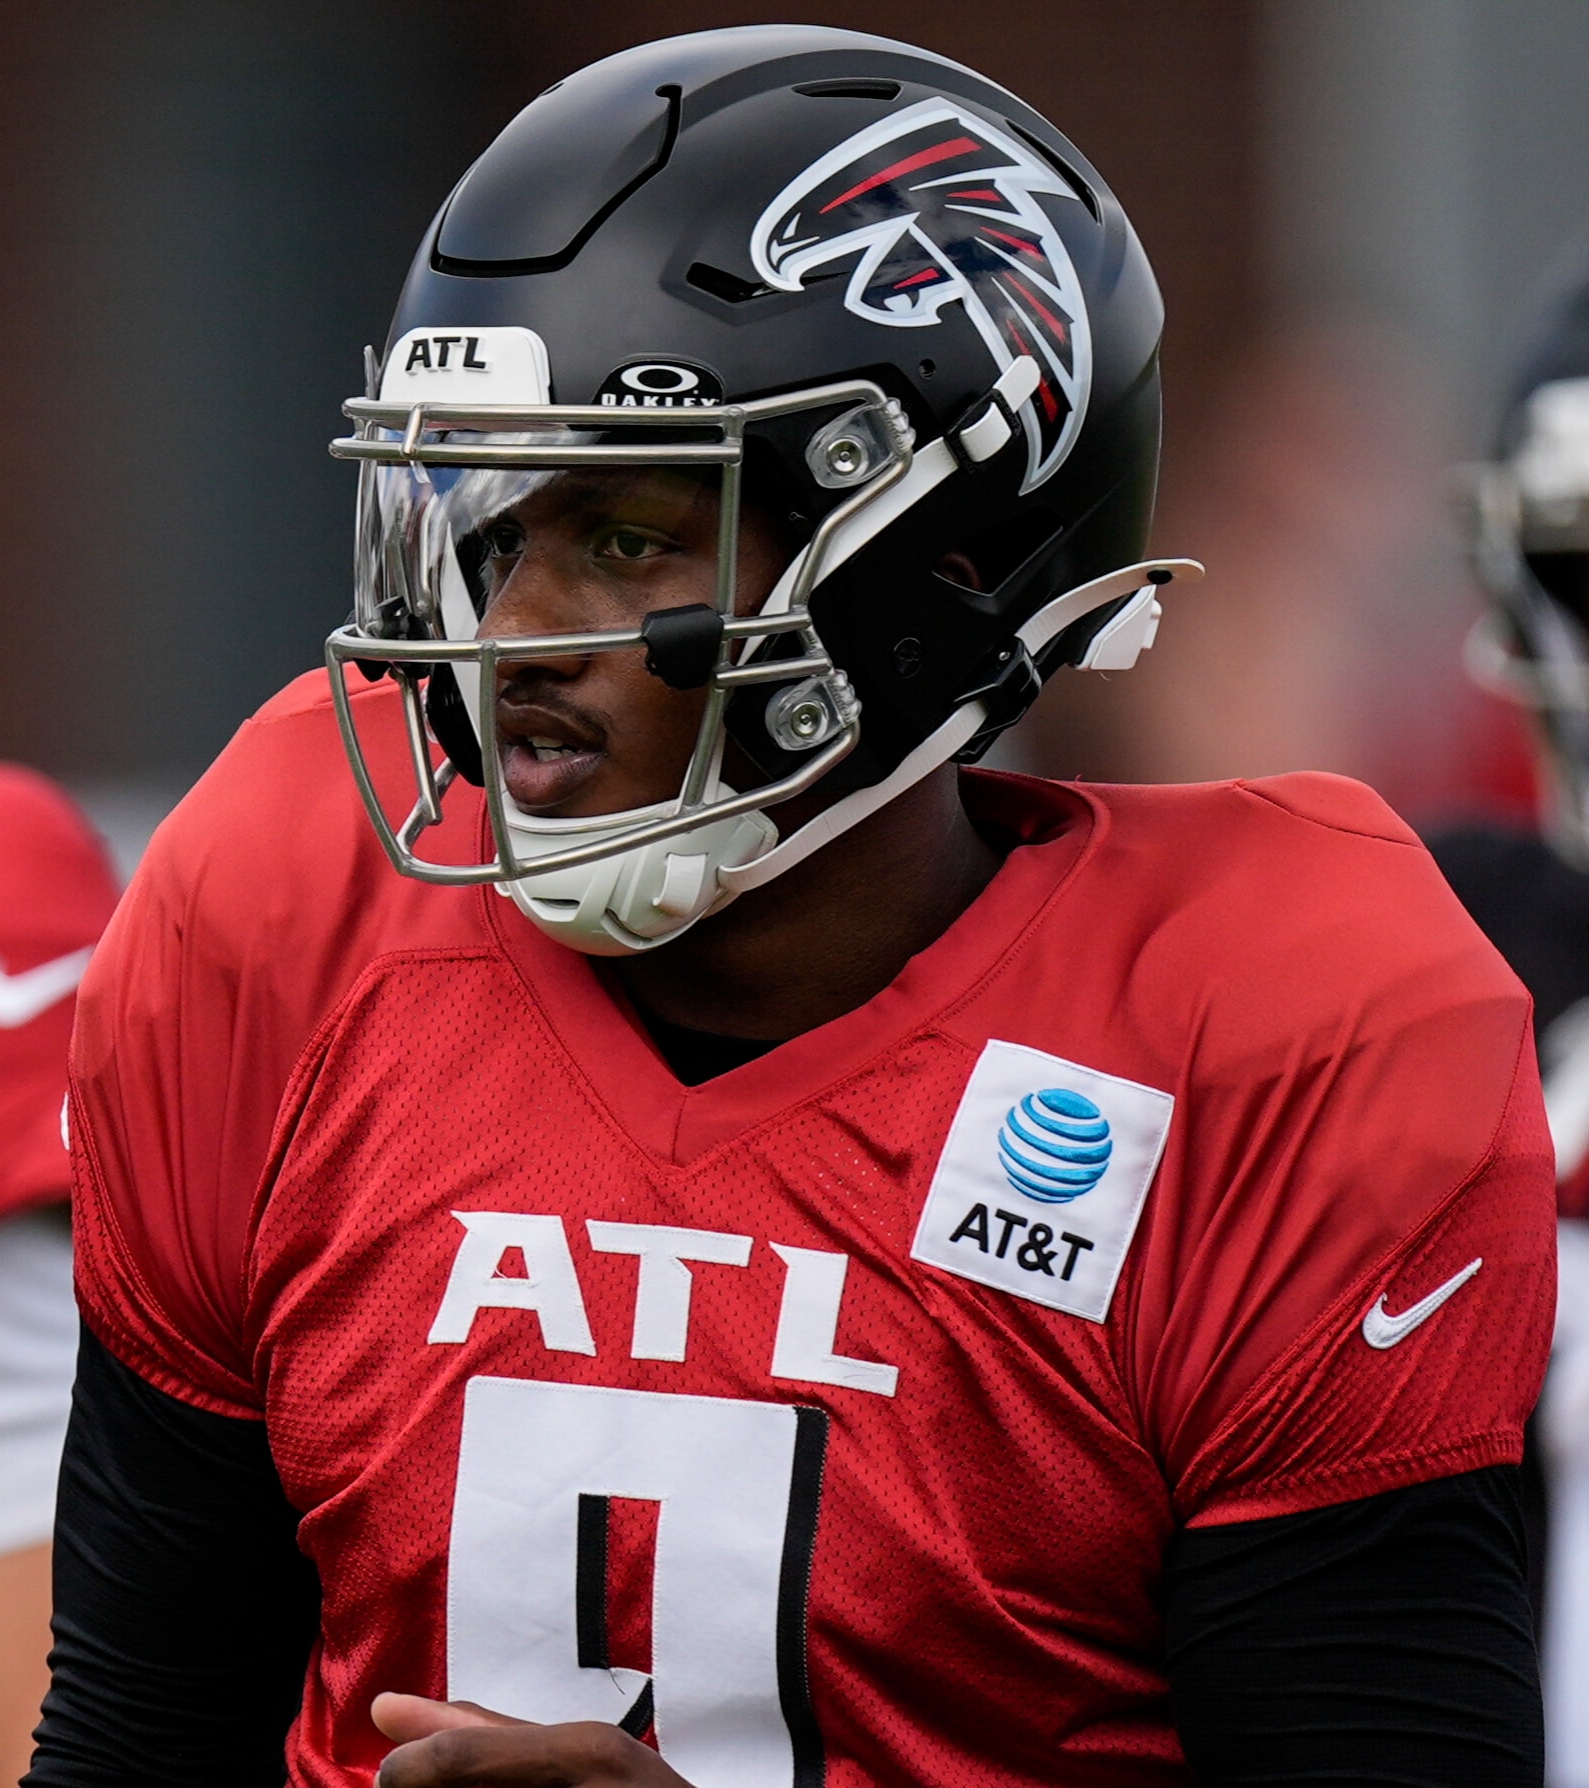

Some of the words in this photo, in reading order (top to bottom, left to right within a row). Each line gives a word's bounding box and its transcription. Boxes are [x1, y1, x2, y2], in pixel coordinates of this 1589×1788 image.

[404, 336, 486, 372] ATL
[427, 1210, 899, 1398] ATL
[948, 1202, 1095, 1281] AT&T
[447, 1375, 829, 1788] 9
